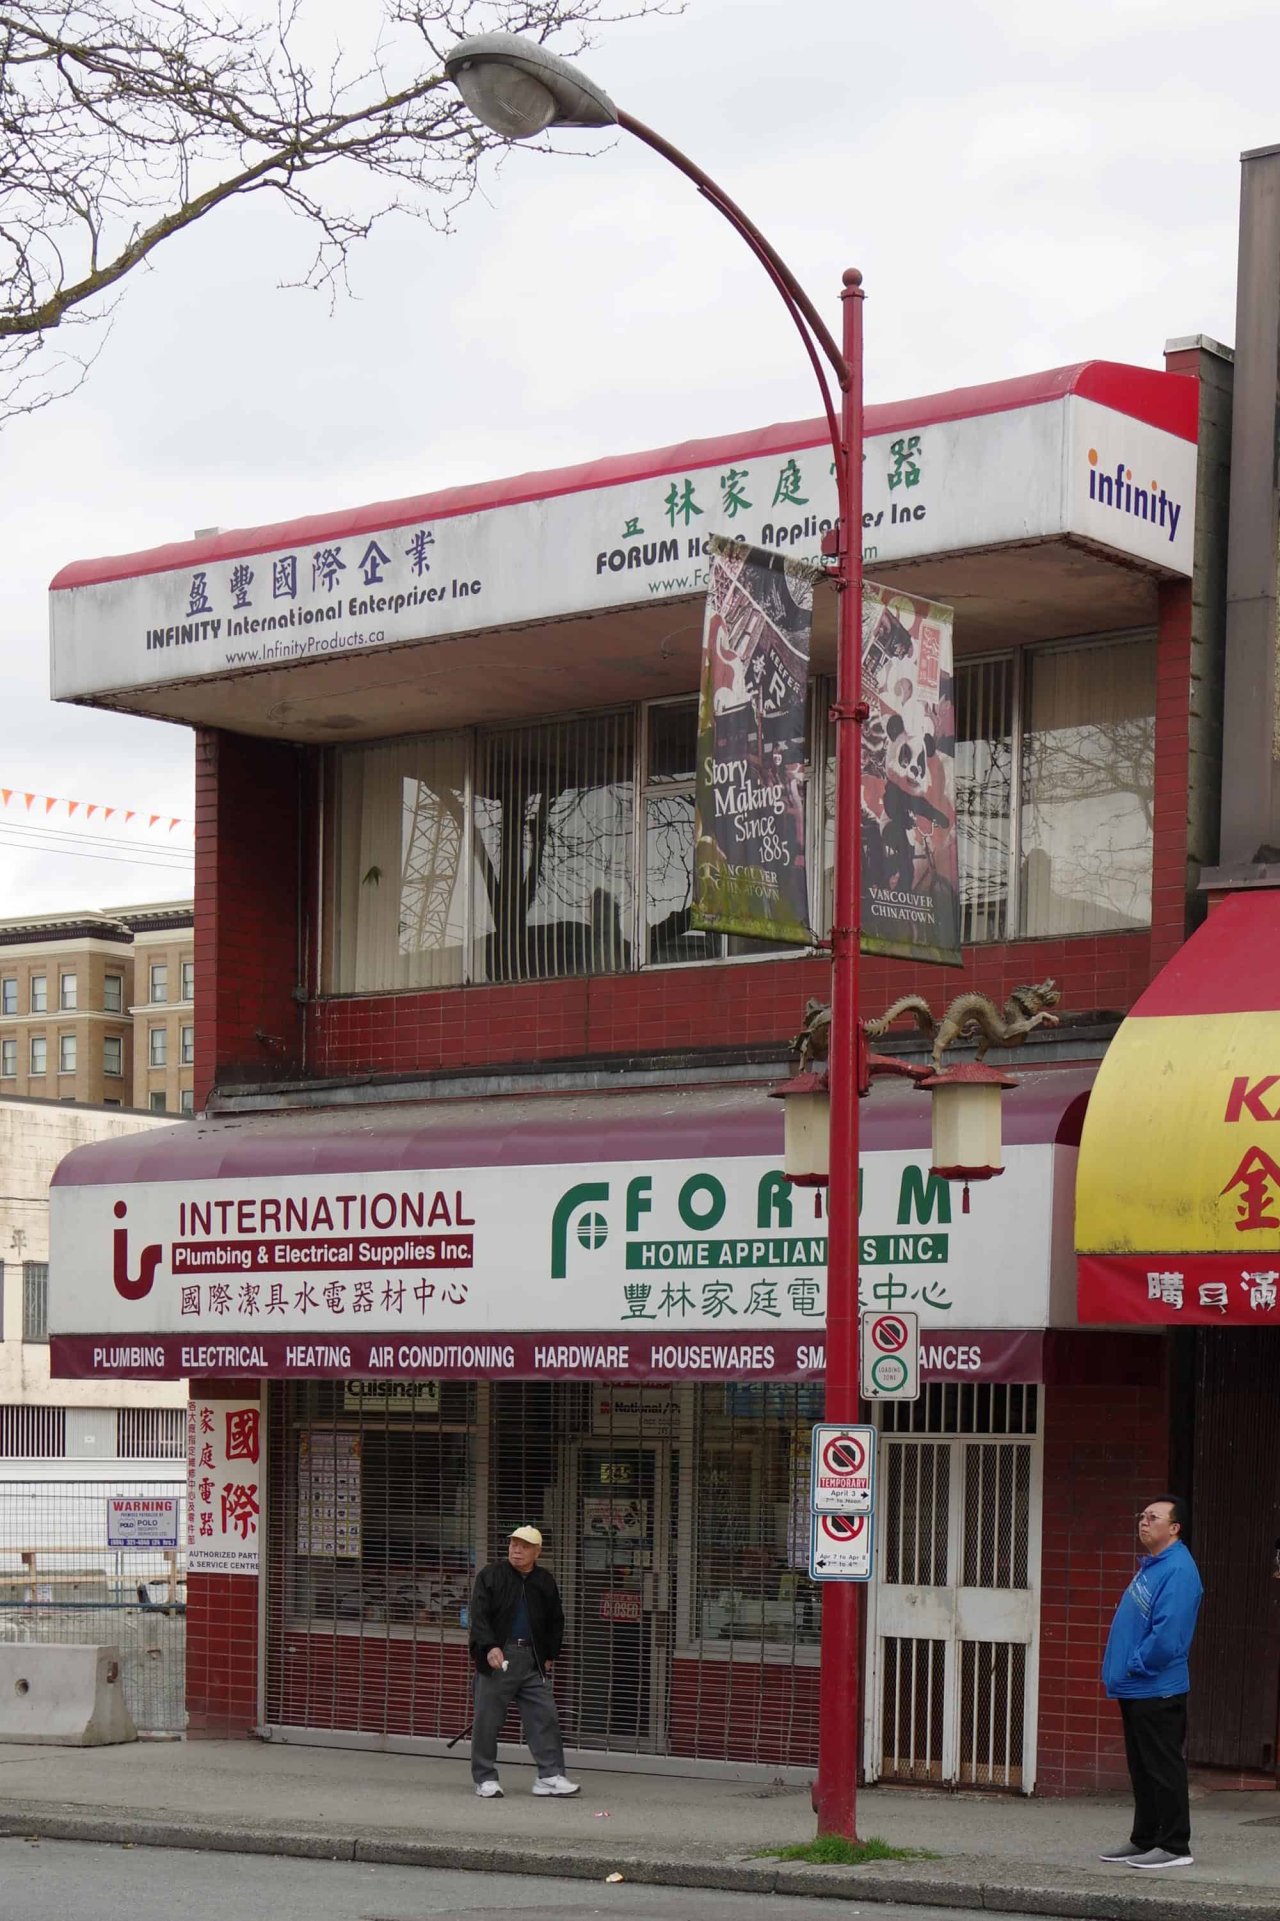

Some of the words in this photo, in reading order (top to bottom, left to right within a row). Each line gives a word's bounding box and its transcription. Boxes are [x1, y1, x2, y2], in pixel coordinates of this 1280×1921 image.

[622, 436, 922, 538] 林家庭器
[1088, 447, 1181, 542] infinity
[596, 539, 679, 575] FORUM
[688, 535, 746, 558] Hoe
[761, 511, 884, 547] Appliaes
[891, 503, 926, 524] Inc
[186, 530, 435, 617] 盈豐國際企業
[146, 619, 221, 650] INFINITY
[227, 600, 342, 637] International
[349, 585, 446, 616] Enterprises
[452, 579, 482, 598] Inc
[225, 630, 385, 664] www.InfinityProducts.ca
[704, 756, 747, 790] Story
[714, 779, 785, 817] Making
[734, 812, 776, 842] Since
[759, 834, 790, 866] 1885
[868, 887, 934, 908] VANCOUVER
[871, 904, 935, 924] CHINATOWN
[1224, 1075, 1280, 1122] K
[626, 1164, 952, 1232] FORM
[1218, 1145, 1280, 1231] 金
[179, 1190, 476, 1237] INTERNATIONAL
[175, 1246, 252, 1269] Plumbing
[256, 1246, 269, 1263] &
[275, 1243, 353, 1263] Electrical
[358, 1241, 436, 1263] Supplies
[441, 1240, 472, 1260] Inc.
[642, 1243, 709, 1266] HOME
[718, 1238, 877, 1265] APPLIANS
[889, 1236, 943, 1261] INC.
[180, 1277, 469, 1316] 國際潔具水電器材中心
[620, 1272, 953, 1321] 豐林家庭電中心
[94, 1346, 165, 1368] PLUMBING
[181, 1346, 269, 1368] ELECTRICAL
[286, 1346, 351, 1368] HEATING
[369, 1346, 394, 1367] AIR
[398, 1345, 515, 1368] CONDITIONING
[534, 1345, 629, 1369] HARDWARE
[651, 1345, 775, 1369] HOUSEWARES
[918, 1346, 982, 1370] ANCES
[347, 1380, 436, 1398] Cuisinart
[199, 1407, 216, 1536] 家庭電器
[221, 1408, 260, 1540] 國際
[821, 1478, 867, 1488] TEMPORARY
[113, 1500, 173, 1512] WARNING
[831, 1489, 848, 1497] April
[189, 1550, 237, 1559] AUTHORIZED
[189, 1560, 195, 1568] &
[196, 1560, 227, 1569] SERVICE
[603, 1600, 639, 1617] CLOSED
